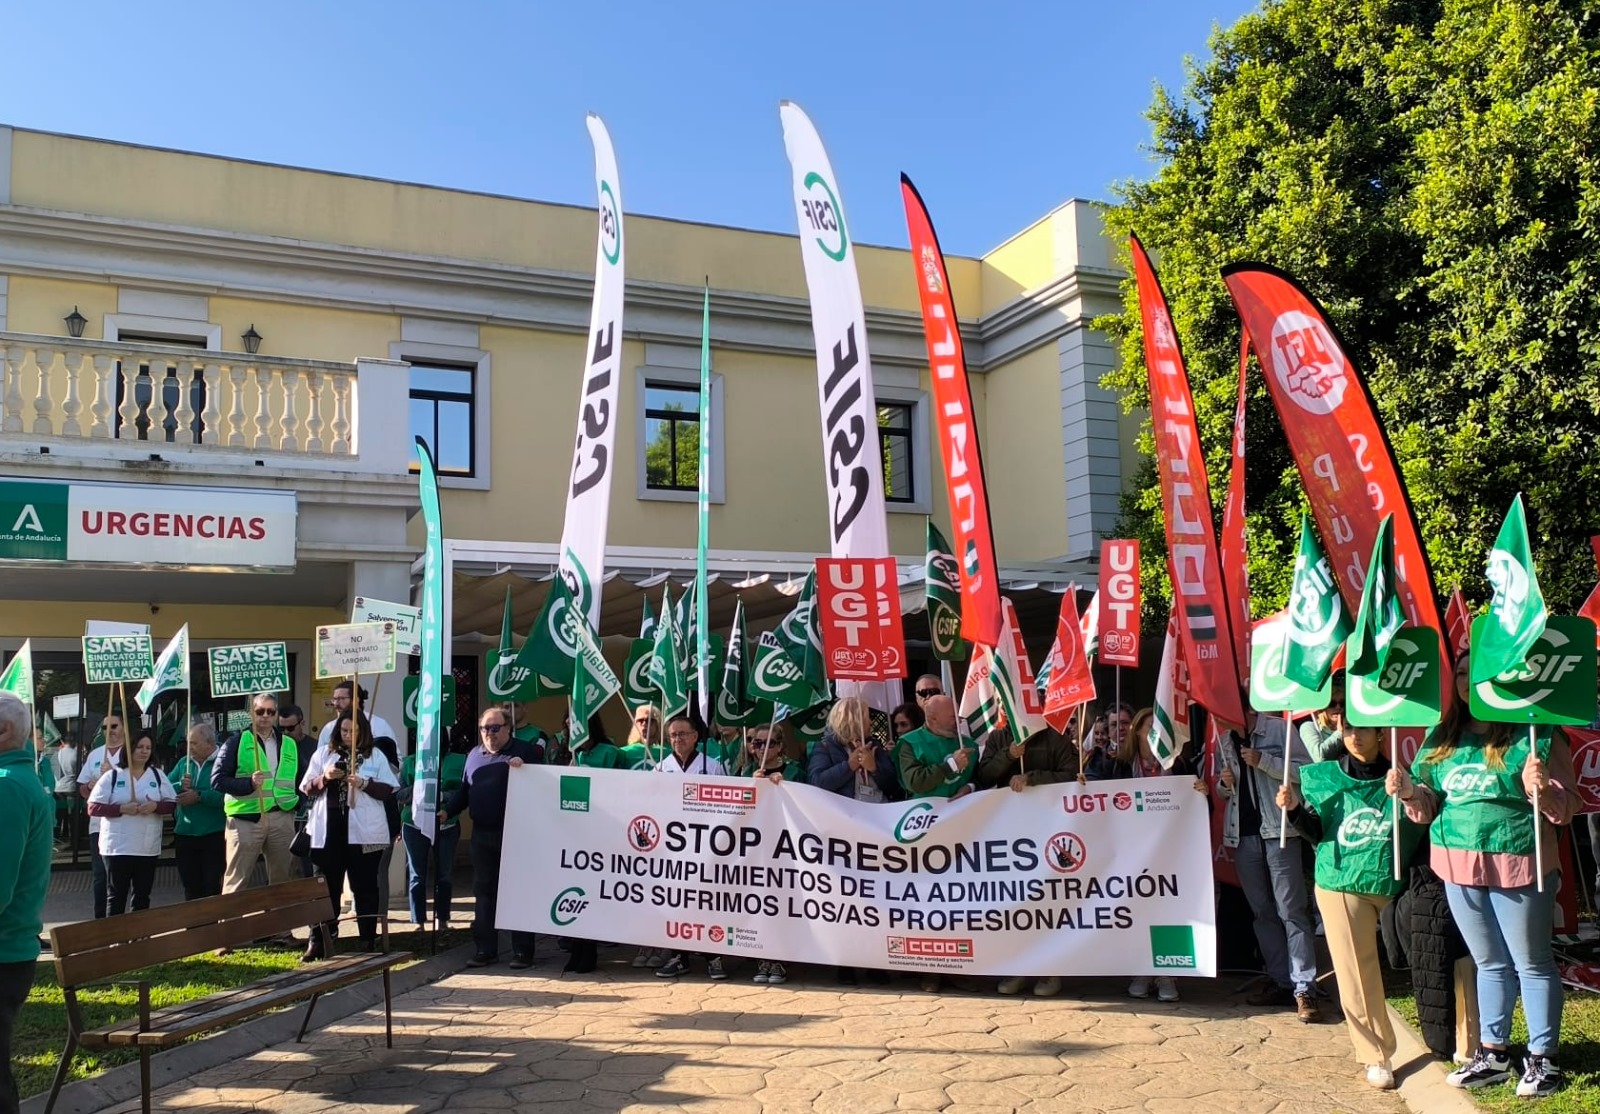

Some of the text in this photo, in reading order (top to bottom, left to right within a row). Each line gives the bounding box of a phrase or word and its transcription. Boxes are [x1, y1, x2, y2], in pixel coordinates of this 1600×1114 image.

[82, 510, 266, 540] URGENCIAS
[25, 534, 61, 542] Andalucía
[1108, 546, 1134, 630] UGT
[829, 564, 869, 647] UGT
[938, 617, 959, 636] CSIF
[87, 638, 149, 653] SATSE
[344, 645, 379, 654] MALTRATO
[88, 652, 149, 662] SINDICATO DE
[213, 645, 283, 665] SATSE
[342, 656, 372, 665] LABORAL
[89, 660, 150, 669] ENFERMERIA
[214, 661, 283, 674] SINDICATO DE
[90, 667, 151, 681] MALAGA
[214, 668, 284, 681] ENFERMERIA
[1381, 662, 1428, 689] SIF
[215, 676, 284, 694] MALAGA
[702, 787, 742, 800] CCOO
[562, 800, 587, 811] SATSE
[1063, 794, 1108, 813] UGT
[903, 812, 939, 831] CSIF
[666, 821, 1039, 874] STOP AGRESIONES
[561, 849, 1179, 902] LOS INCUMPLIMIENTOS DE LA ADMINISTRACIÓN
[557, 898, 589, 914] CSIF
[600, 879, 1133, 932] LOS SUFRIMOS LOS/AS PROFESIONALES
[666, 921, 705, 941] UGT
[736, 940, 763, 949] Andalucía
[909, 941, 957, 953] CCOO
[1155, 954, 1193, 967] SATSE
